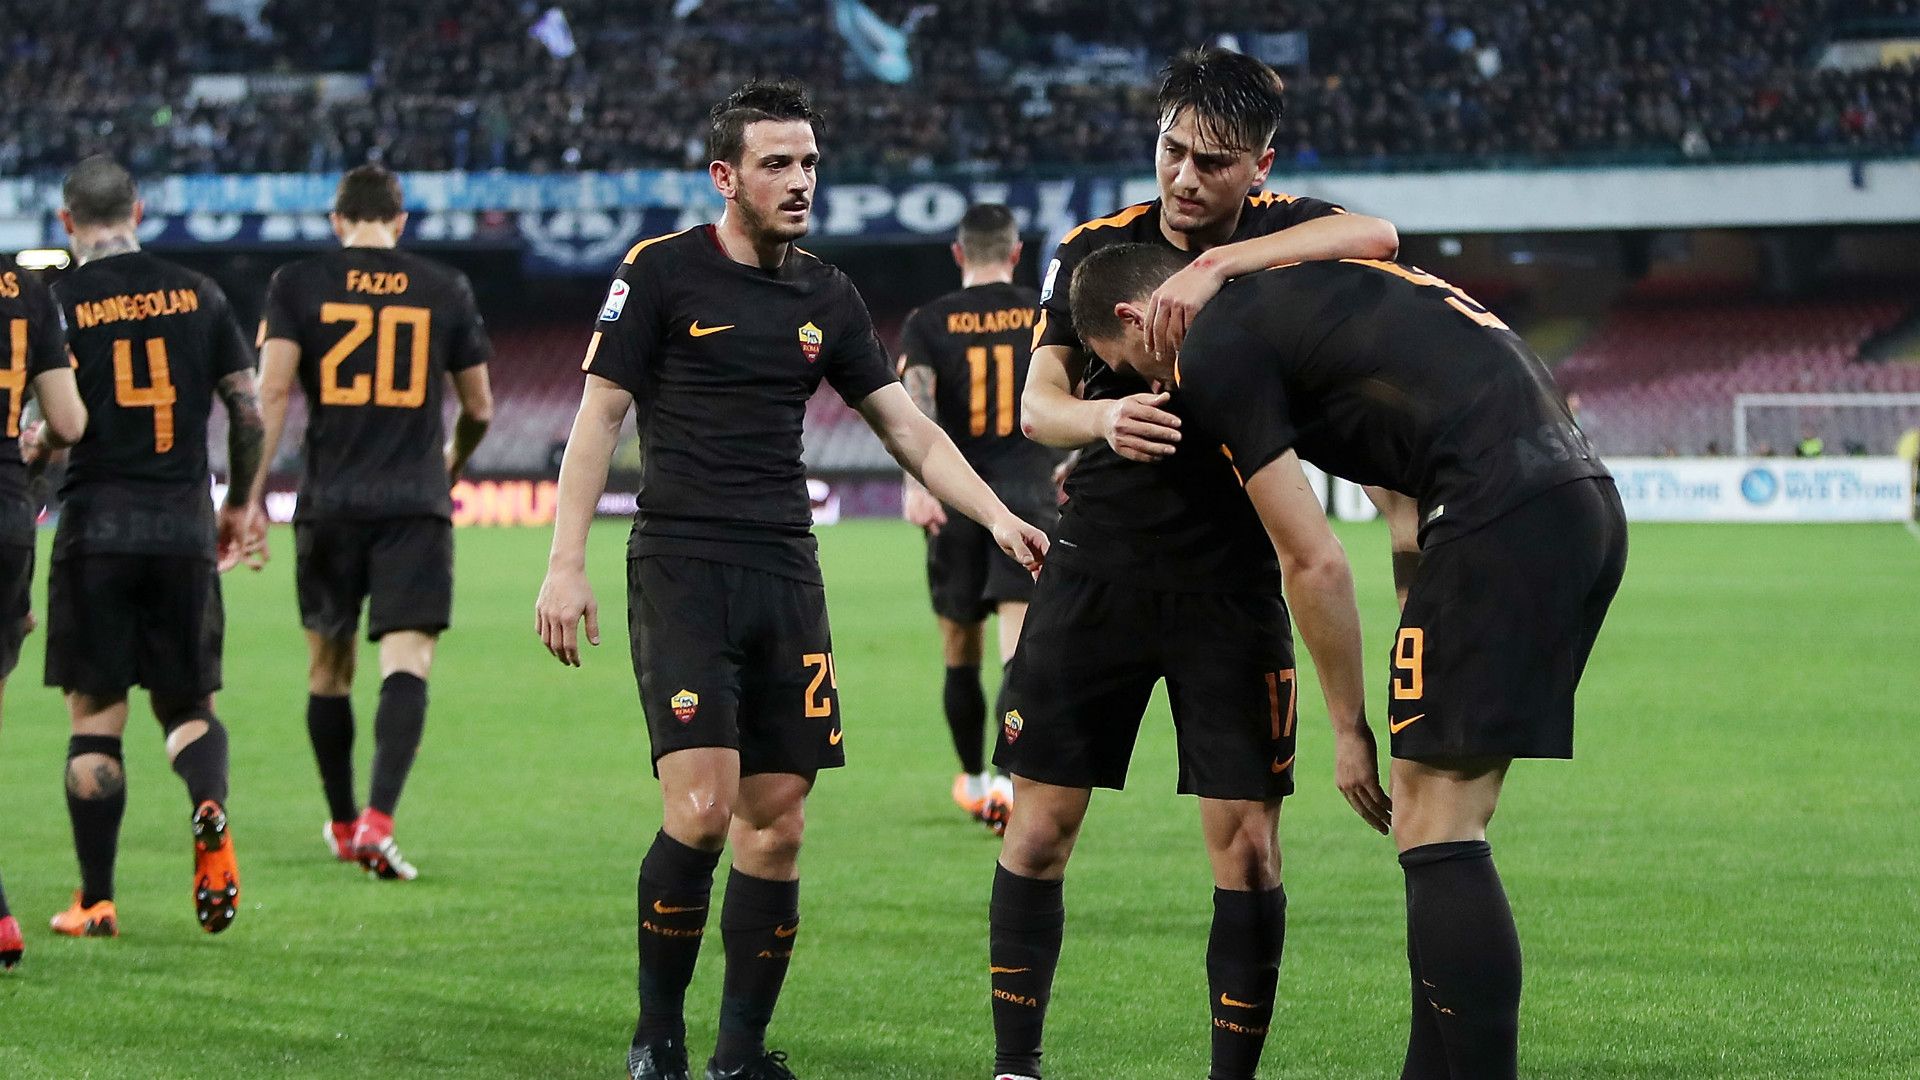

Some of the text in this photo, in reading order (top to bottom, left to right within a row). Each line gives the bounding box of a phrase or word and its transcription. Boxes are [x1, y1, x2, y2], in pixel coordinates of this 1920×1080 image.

[75, 288, 199, 329] NAINGGOLAN
[346, 269, 410, 296] FAZIO
[319, 301, 432, 409] 20
[947, 307, 1035, 334] KOLAROV
[112, 336, 177, 454] 4
[965, 344, 1015, 438] 11
[1393, 627, 1424, 700] 9
[1264, 668, 1296, 740] 17
